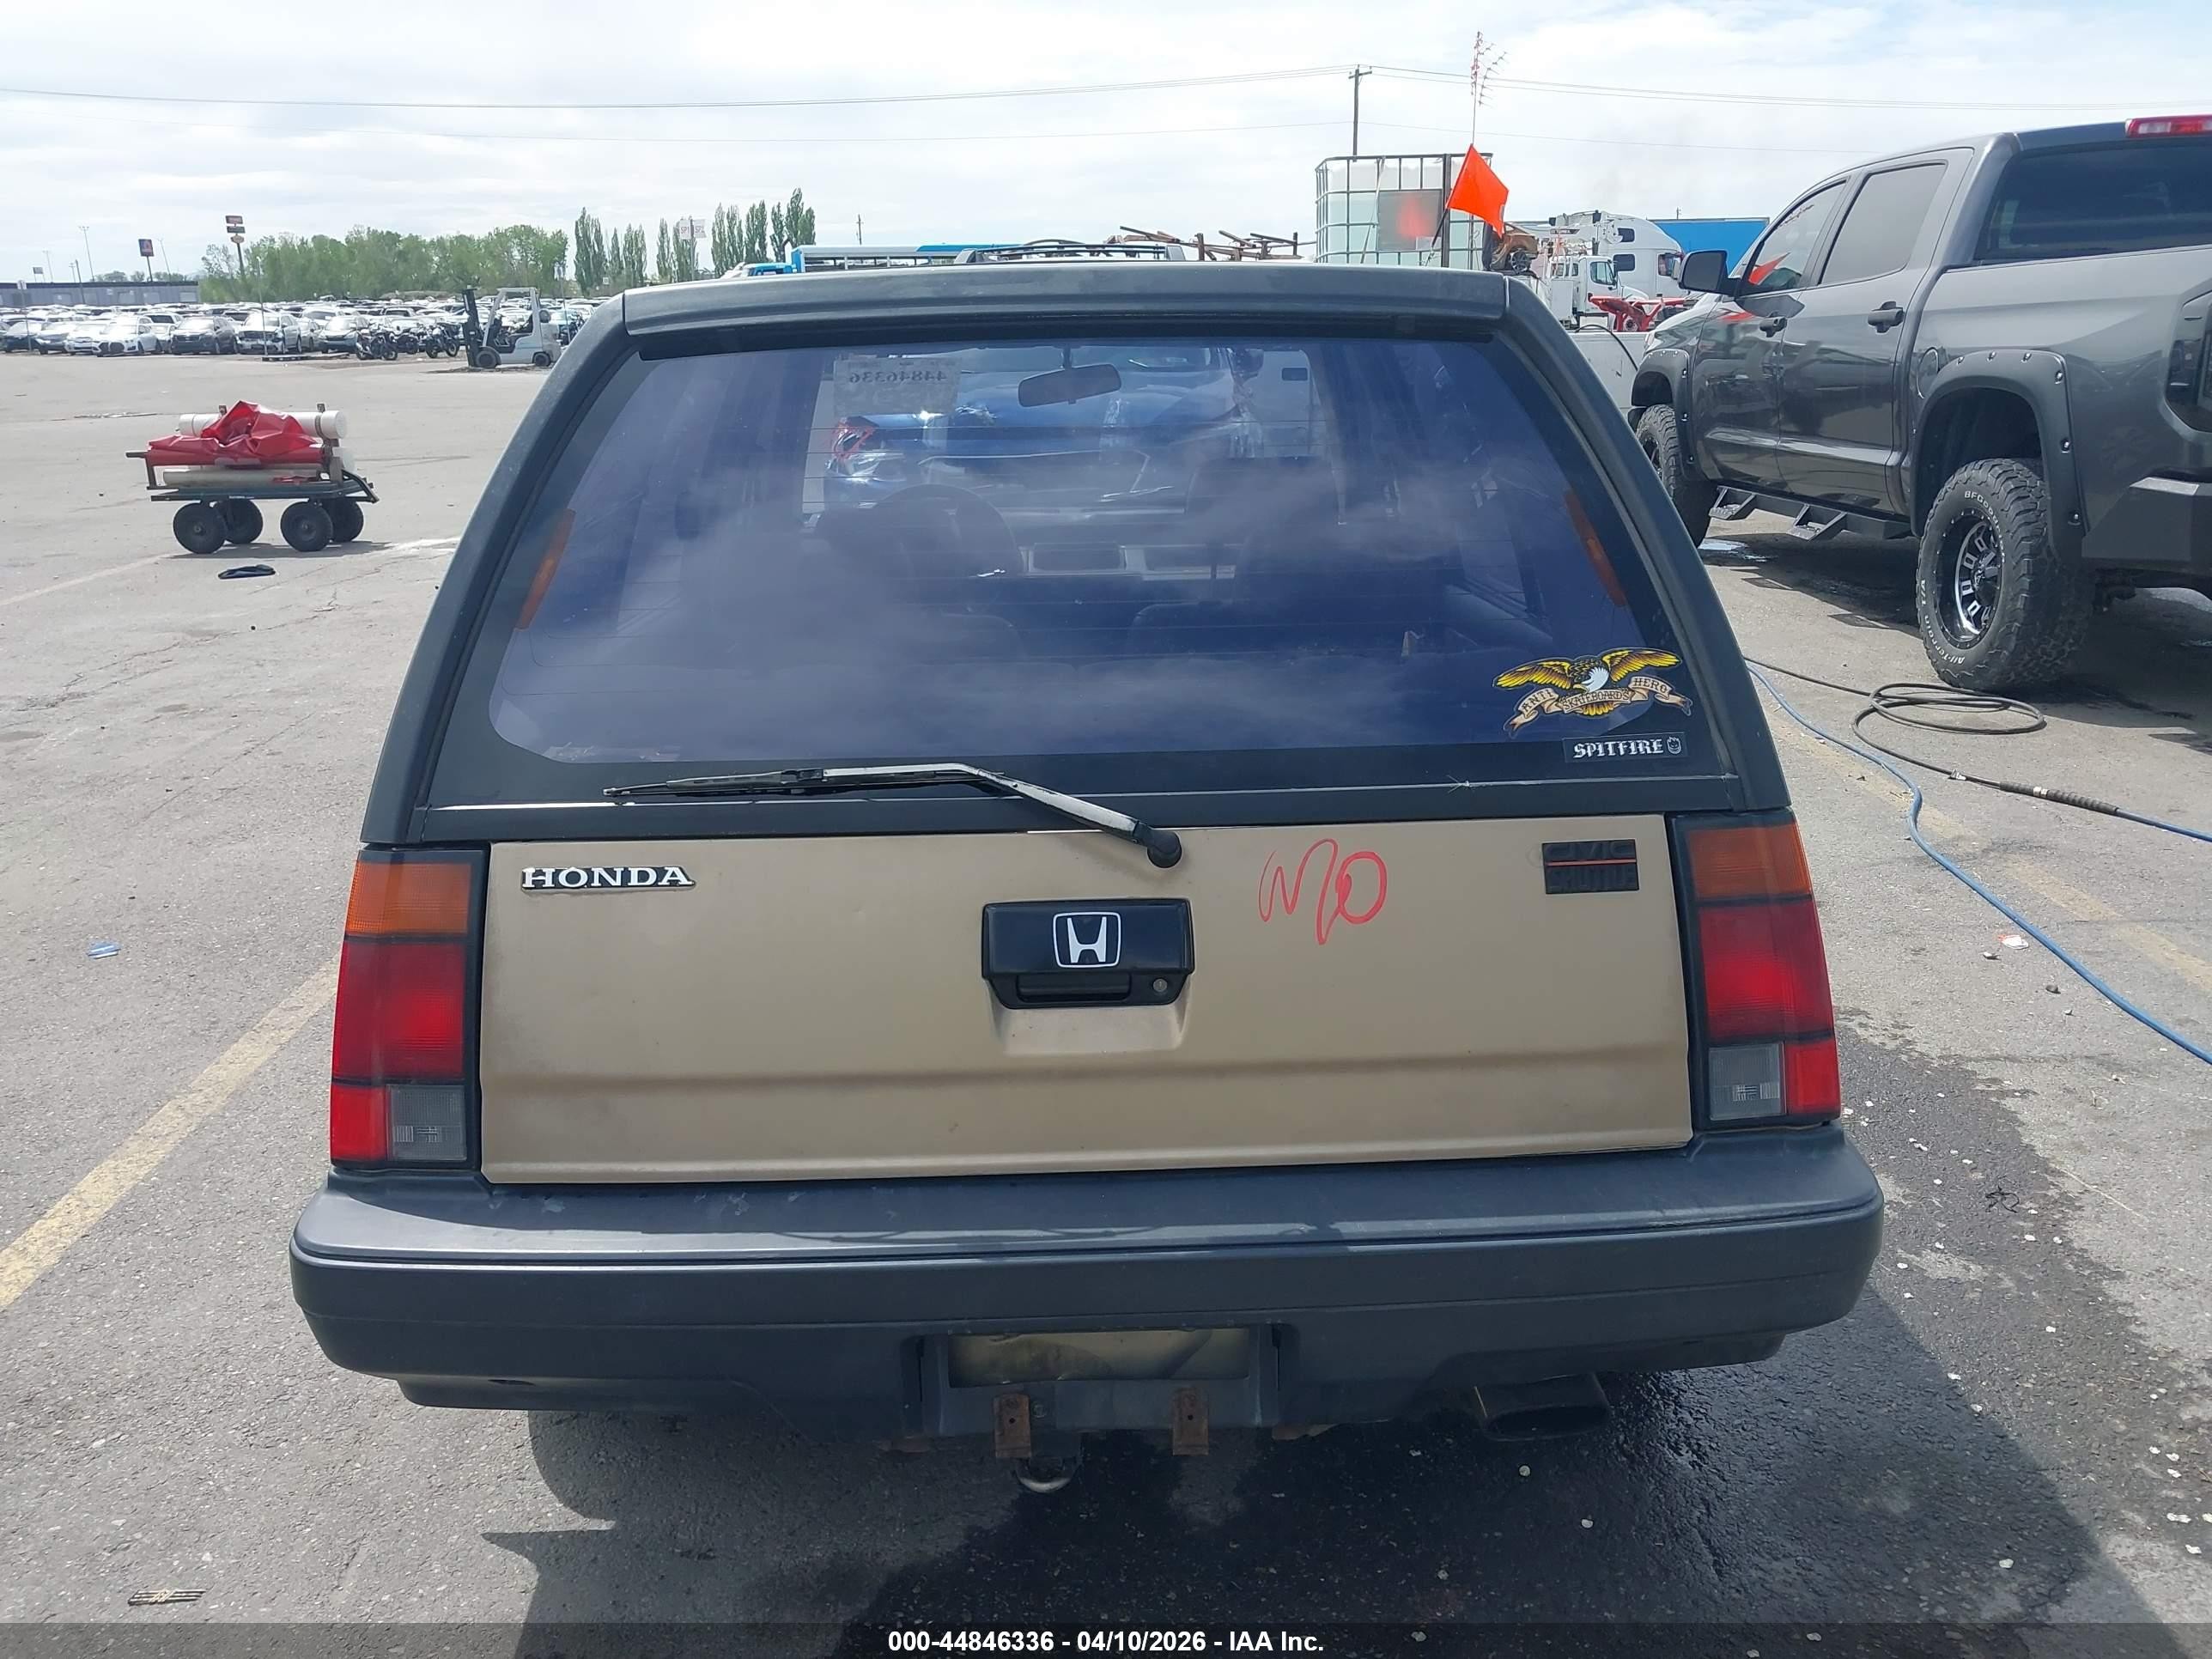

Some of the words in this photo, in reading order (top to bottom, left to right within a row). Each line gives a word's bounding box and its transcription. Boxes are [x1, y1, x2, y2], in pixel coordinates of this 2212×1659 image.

[1522, 689, 1553, 713] ANTI
[1635, 678, 1668, 694] HERO
[1562, 690, 1630, 711] SKATEBOARDS
[1573, 738, 1664, 758] SPITFIRE
[522, 866, 695, 889] HONDA
